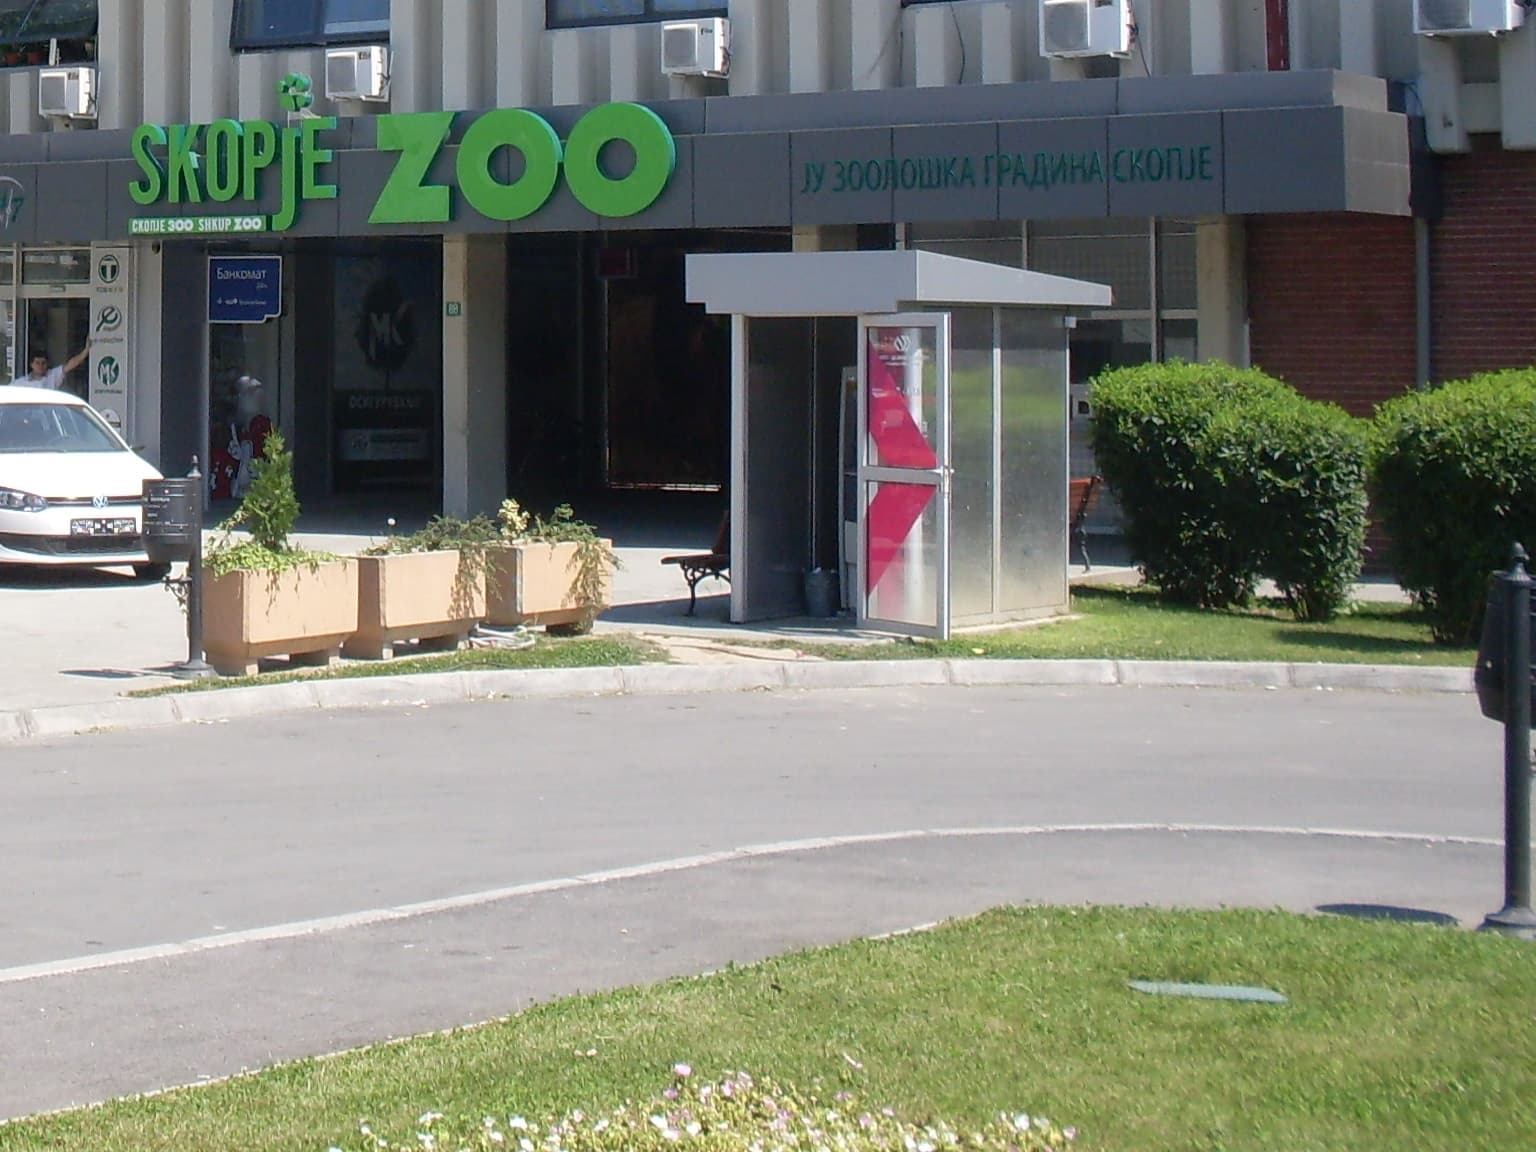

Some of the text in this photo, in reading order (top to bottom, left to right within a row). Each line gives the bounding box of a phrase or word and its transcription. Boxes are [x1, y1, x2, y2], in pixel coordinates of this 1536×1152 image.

[368, 102, 675, 224] ZOO
[831, 157, 975, 194] ЗООЛОШКА
[983, 150, 1104, 191] ГРАДИНА
[1112, 145, 1214, 183] СКОПЈЕ
[198, 217, 262, 232] SHKUP ZOO
[216, 267, 268, 280] Банкомат
